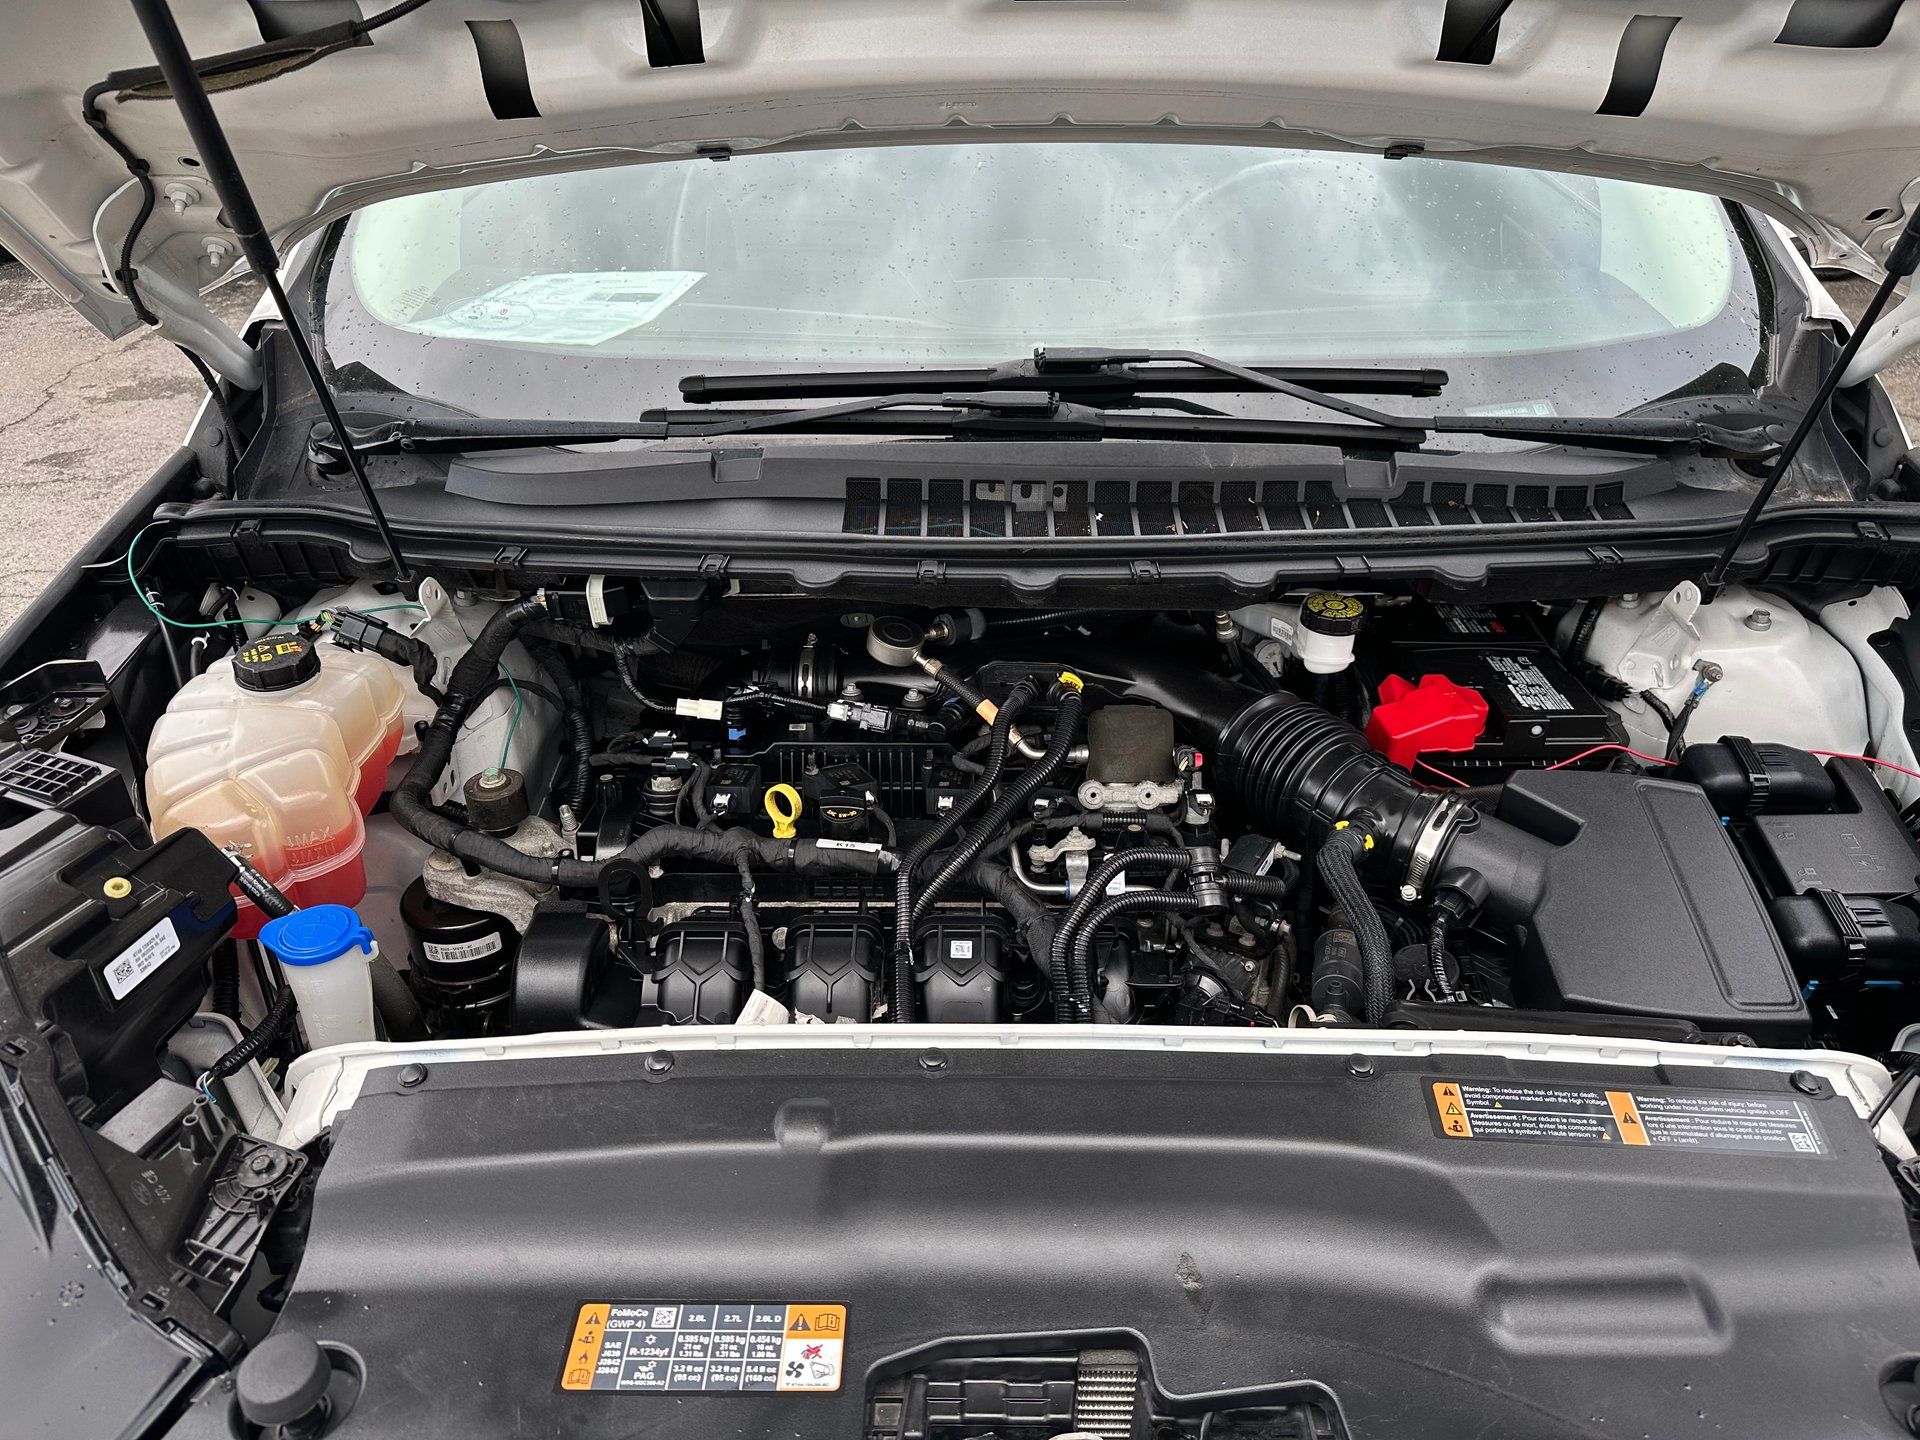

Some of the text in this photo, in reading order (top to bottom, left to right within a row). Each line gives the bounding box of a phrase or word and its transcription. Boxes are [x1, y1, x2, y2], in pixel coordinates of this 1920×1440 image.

[1636, 1096, 1666, 1104] Warning:
[611, 1308, 649, 1317] FoMoCo
[688, 1314, 782, 1323] 2.0L 2.7L 2.0L D
[606, 1320, 646, 1329] (GWP 4)
[678, 1335, 709, 1344] 0.595 kg
[714, 1335, 746, 1345] 0.595 kg
[750, 1335, 781, 1345] 0.454 kg
[629, 1347, 669, 1357] R-1234yf
[746, 1365, 759, 1373] 5.4
[634, 1372, 654, 1380] PAG
[674, 1374, 701, 1382] (95 cc)
[711, 1374, 738, 1382] (95 cc)
[745, 1374, 776, 1383] (160 cc)
